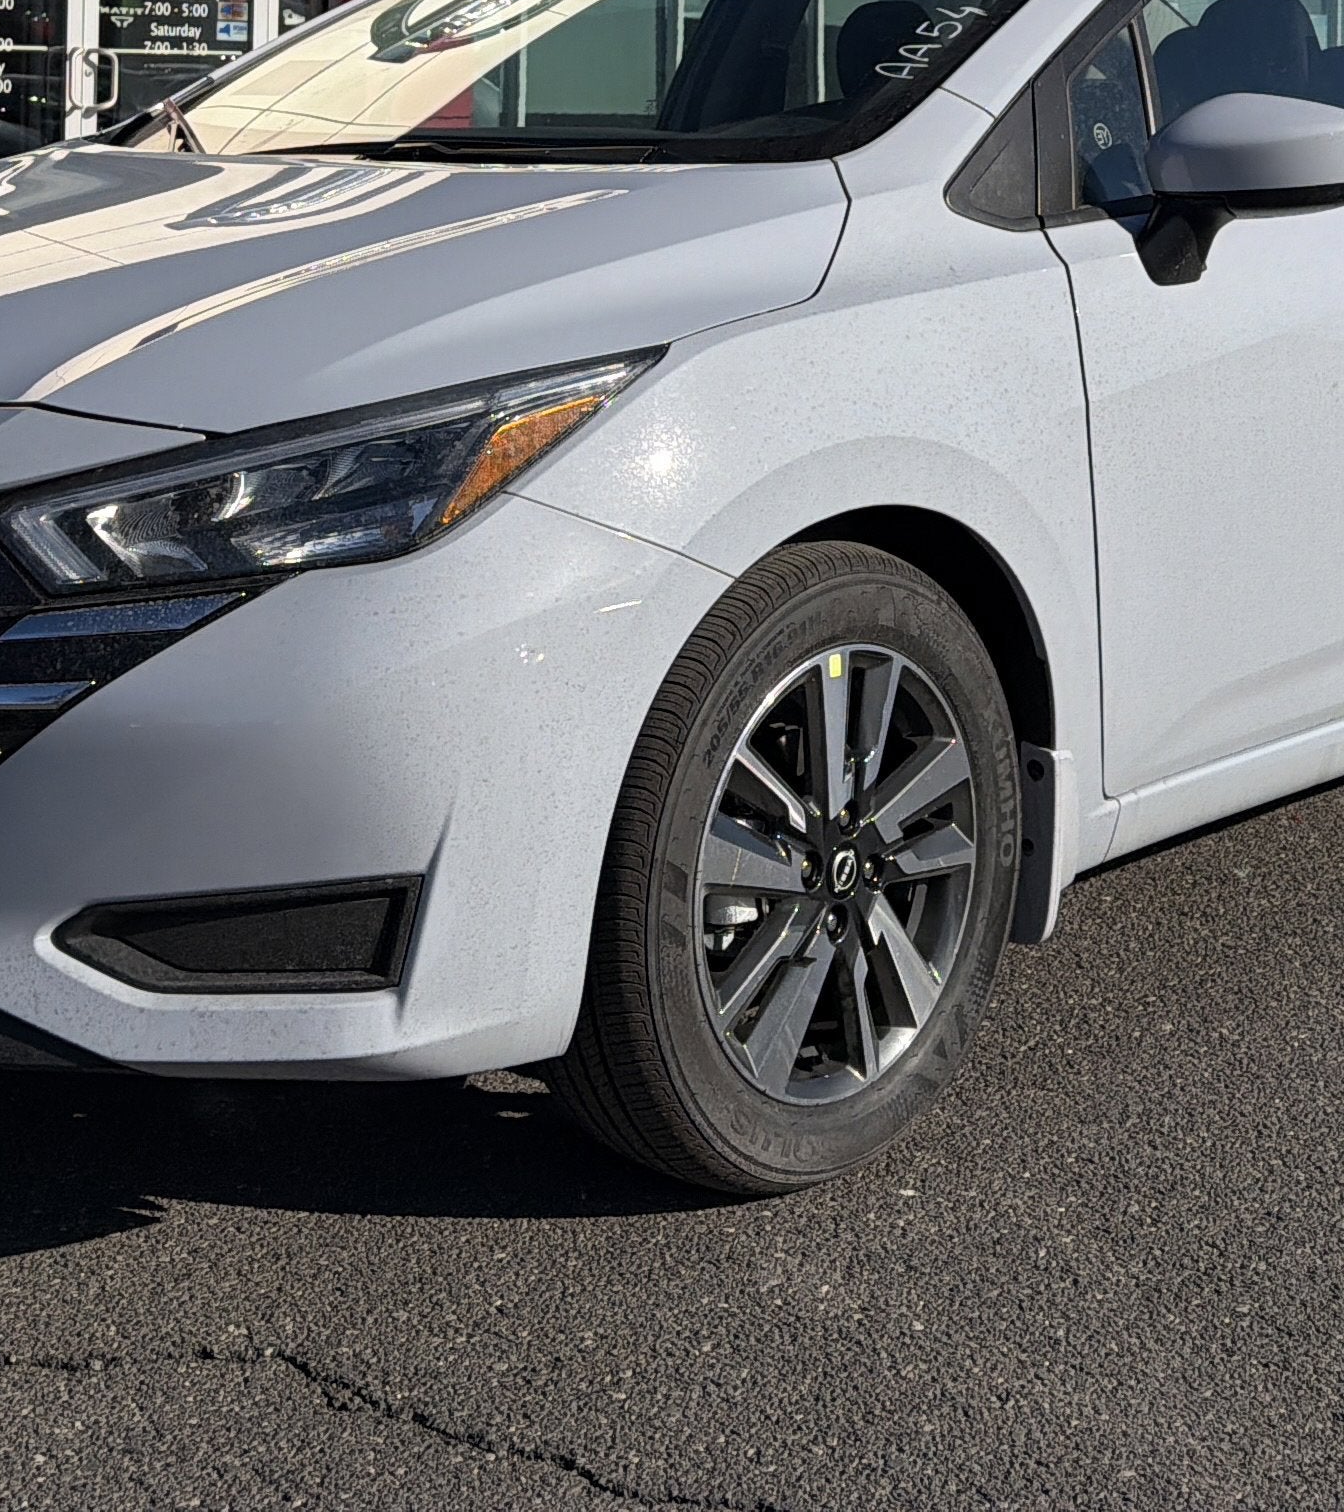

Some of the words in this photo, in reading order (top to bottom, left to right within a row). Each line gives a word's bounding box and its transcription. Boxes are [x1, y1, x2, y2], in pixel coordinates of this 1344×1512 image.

[144, 1, 171, 16] 7:00
[182, 3, 209, 18] 5:00
[150, 22, 202, 40] Saturday
[144, 41, 170, 56] 7:00
[182, 42, 208, 56] 1:30
[875, 6, 988, 79] AA54
